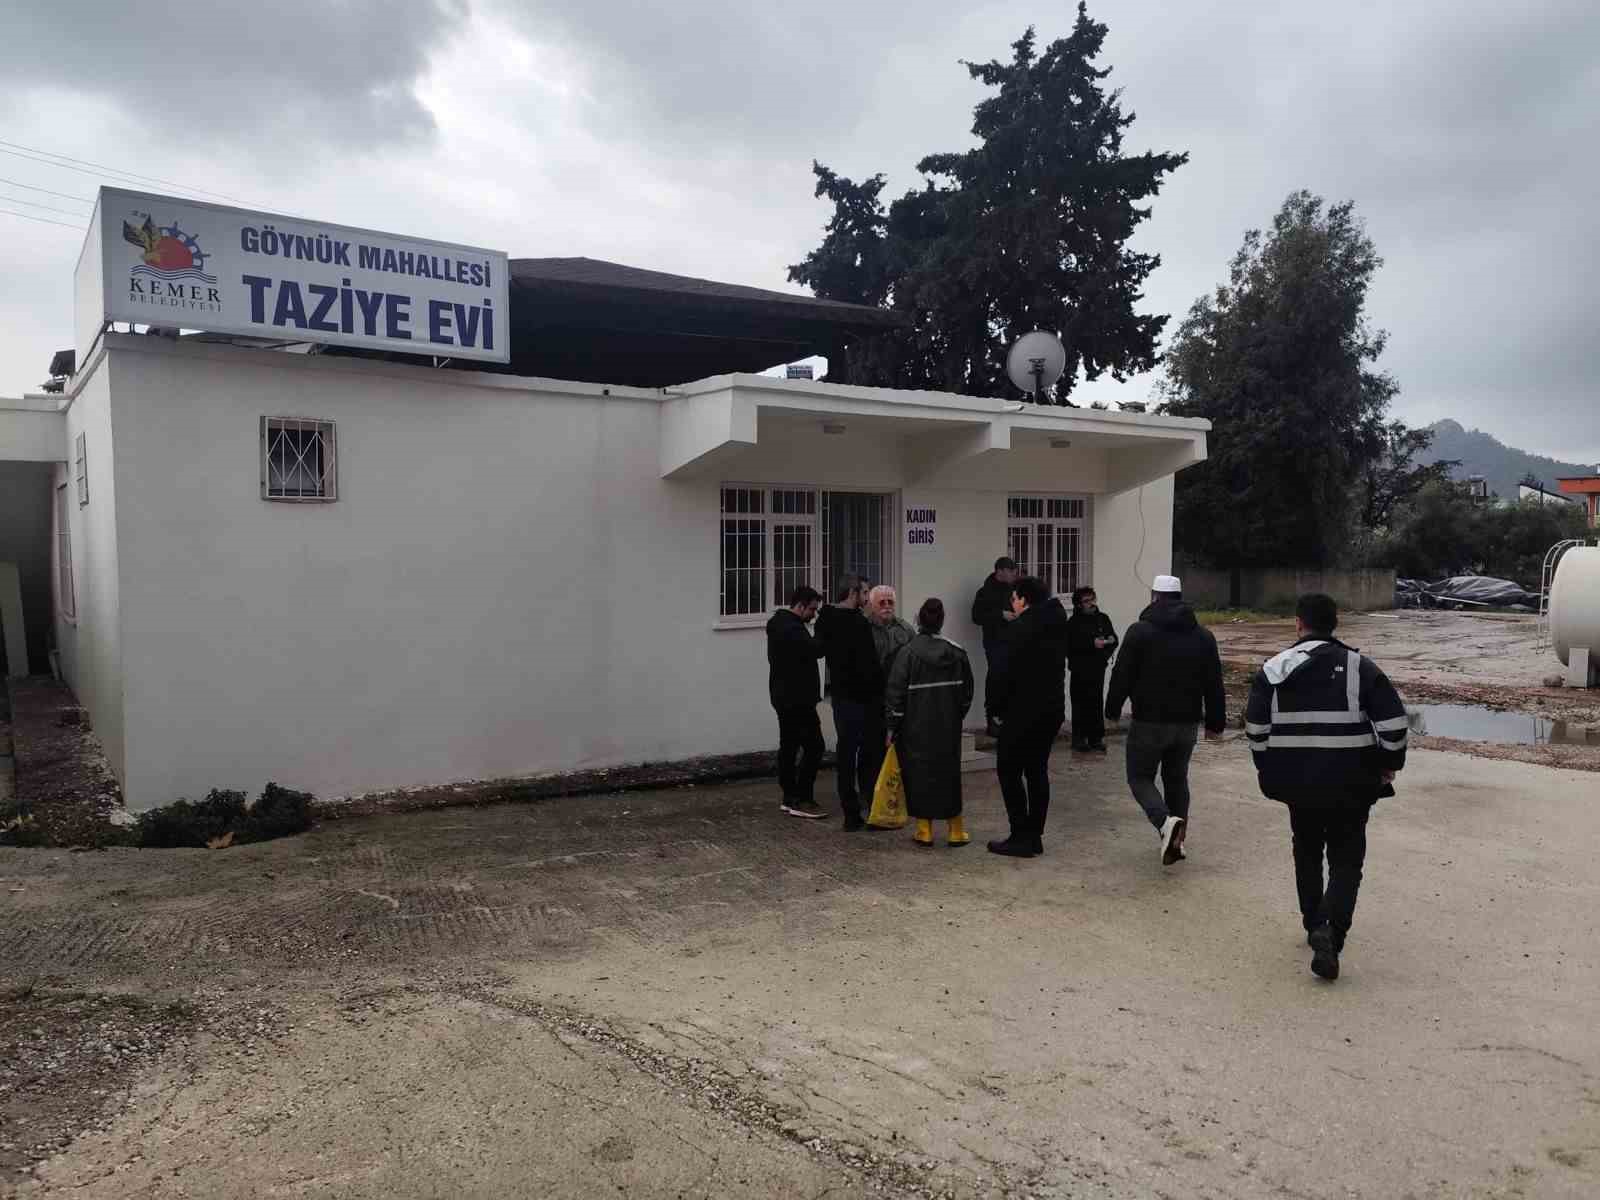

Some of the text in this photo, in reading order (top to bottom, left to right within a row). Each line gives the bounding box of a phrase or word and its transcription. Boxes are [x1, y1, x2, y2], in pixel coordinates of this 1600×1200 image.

[240, 225, 491, 288] GÖYNÜK MAHALLESİ
[129, 278, 221, 302] KEMER
[242, 274, 494, 350] TAZİYE EVİ
[906, 509, 936, 524] KADIN
